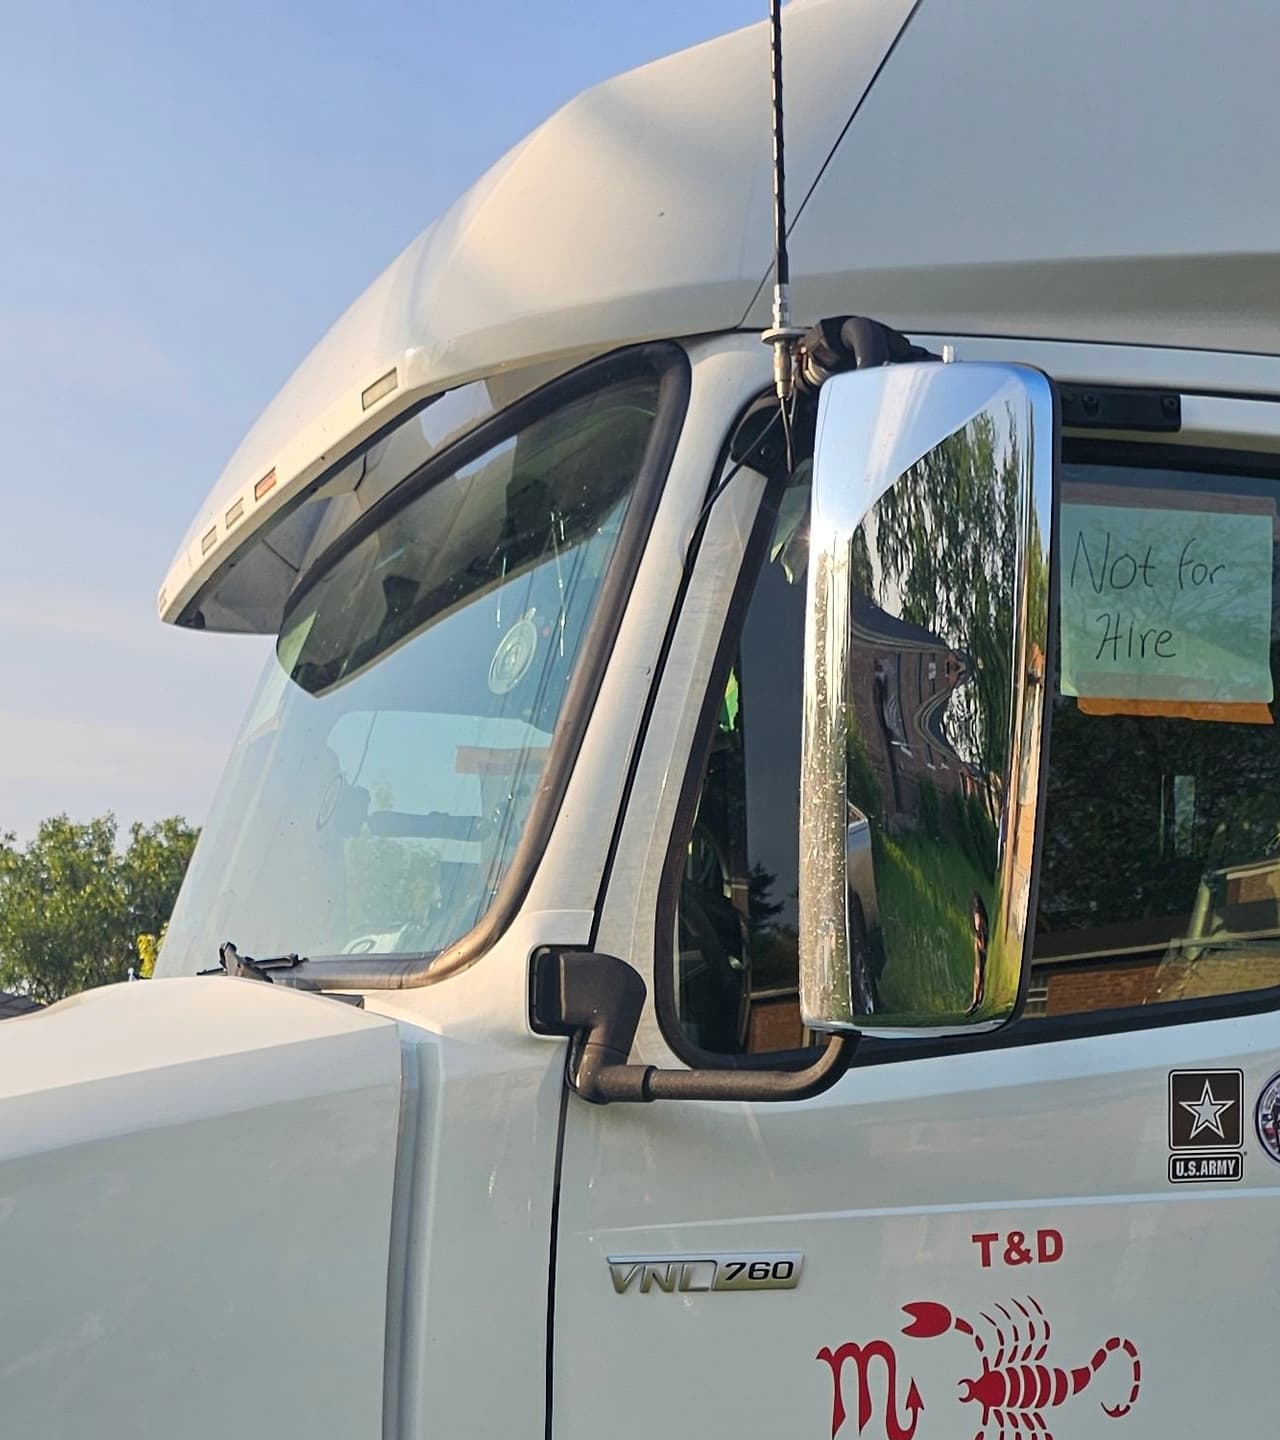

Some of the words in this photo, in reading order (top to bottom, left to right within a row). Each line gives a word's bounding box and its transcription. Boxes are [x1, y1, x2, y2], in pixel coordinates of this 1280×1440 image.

[1070, 530, 1156, 594] Not
[971, 1229, 1064, 1267] T&D
[608, 1263, 710, 1294] VNL
[724, 1261, 794, 1282] 760
